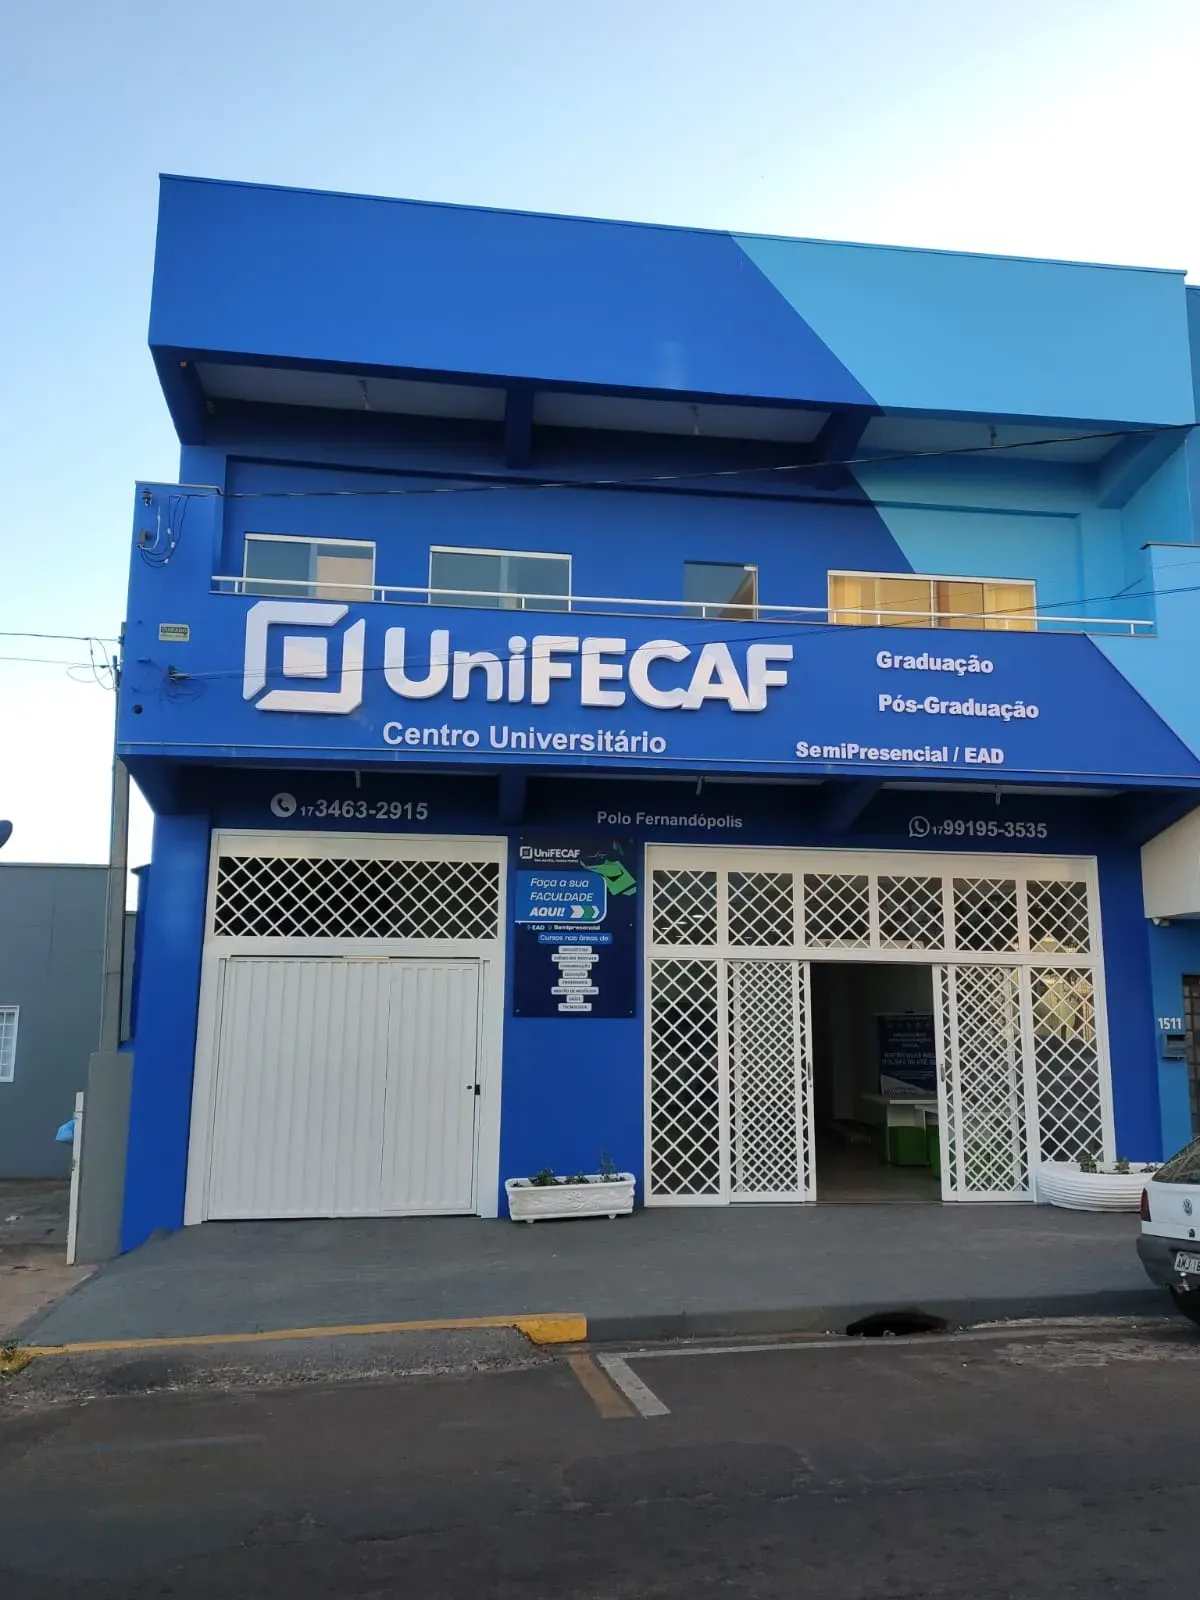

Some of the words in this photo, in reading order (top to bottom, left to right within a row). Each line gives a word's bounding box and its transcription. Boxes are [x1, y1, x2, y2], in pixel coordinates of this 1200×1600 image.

[384, 626, 793, 711] UniFECAF
[876, 650, 994, 677] Graduação
[878, 693, 1040, 722] Pós-Graduação
[382, 721, 480, 748] Centro
[488, 725, 667, 754] Universitário
[796, 741, 948, 762] SemiPresencial
[952, 746, 959, 762] /
[964, 747, 1005, 765] EAD
[300, 806, 315, 817] 17
[315, 799, 429, 820] 3463-2915
[597, 810, 632, 825] Polo
[636, 811, 744, 830] Fernandópolis
[943, 819, 1048, 838] 99195-3535
[534, 848, 580, 858] UniFECAF
[530, 877, 557, 889] Faça
[559, 879, 567, 887] a
[568, 879, 589, 888] sua
[530, 892, 594, 902] FACULDADE
[529, 907, 565, 917] AQUI!
[1158, 1017, 1182, 1030] 1511
